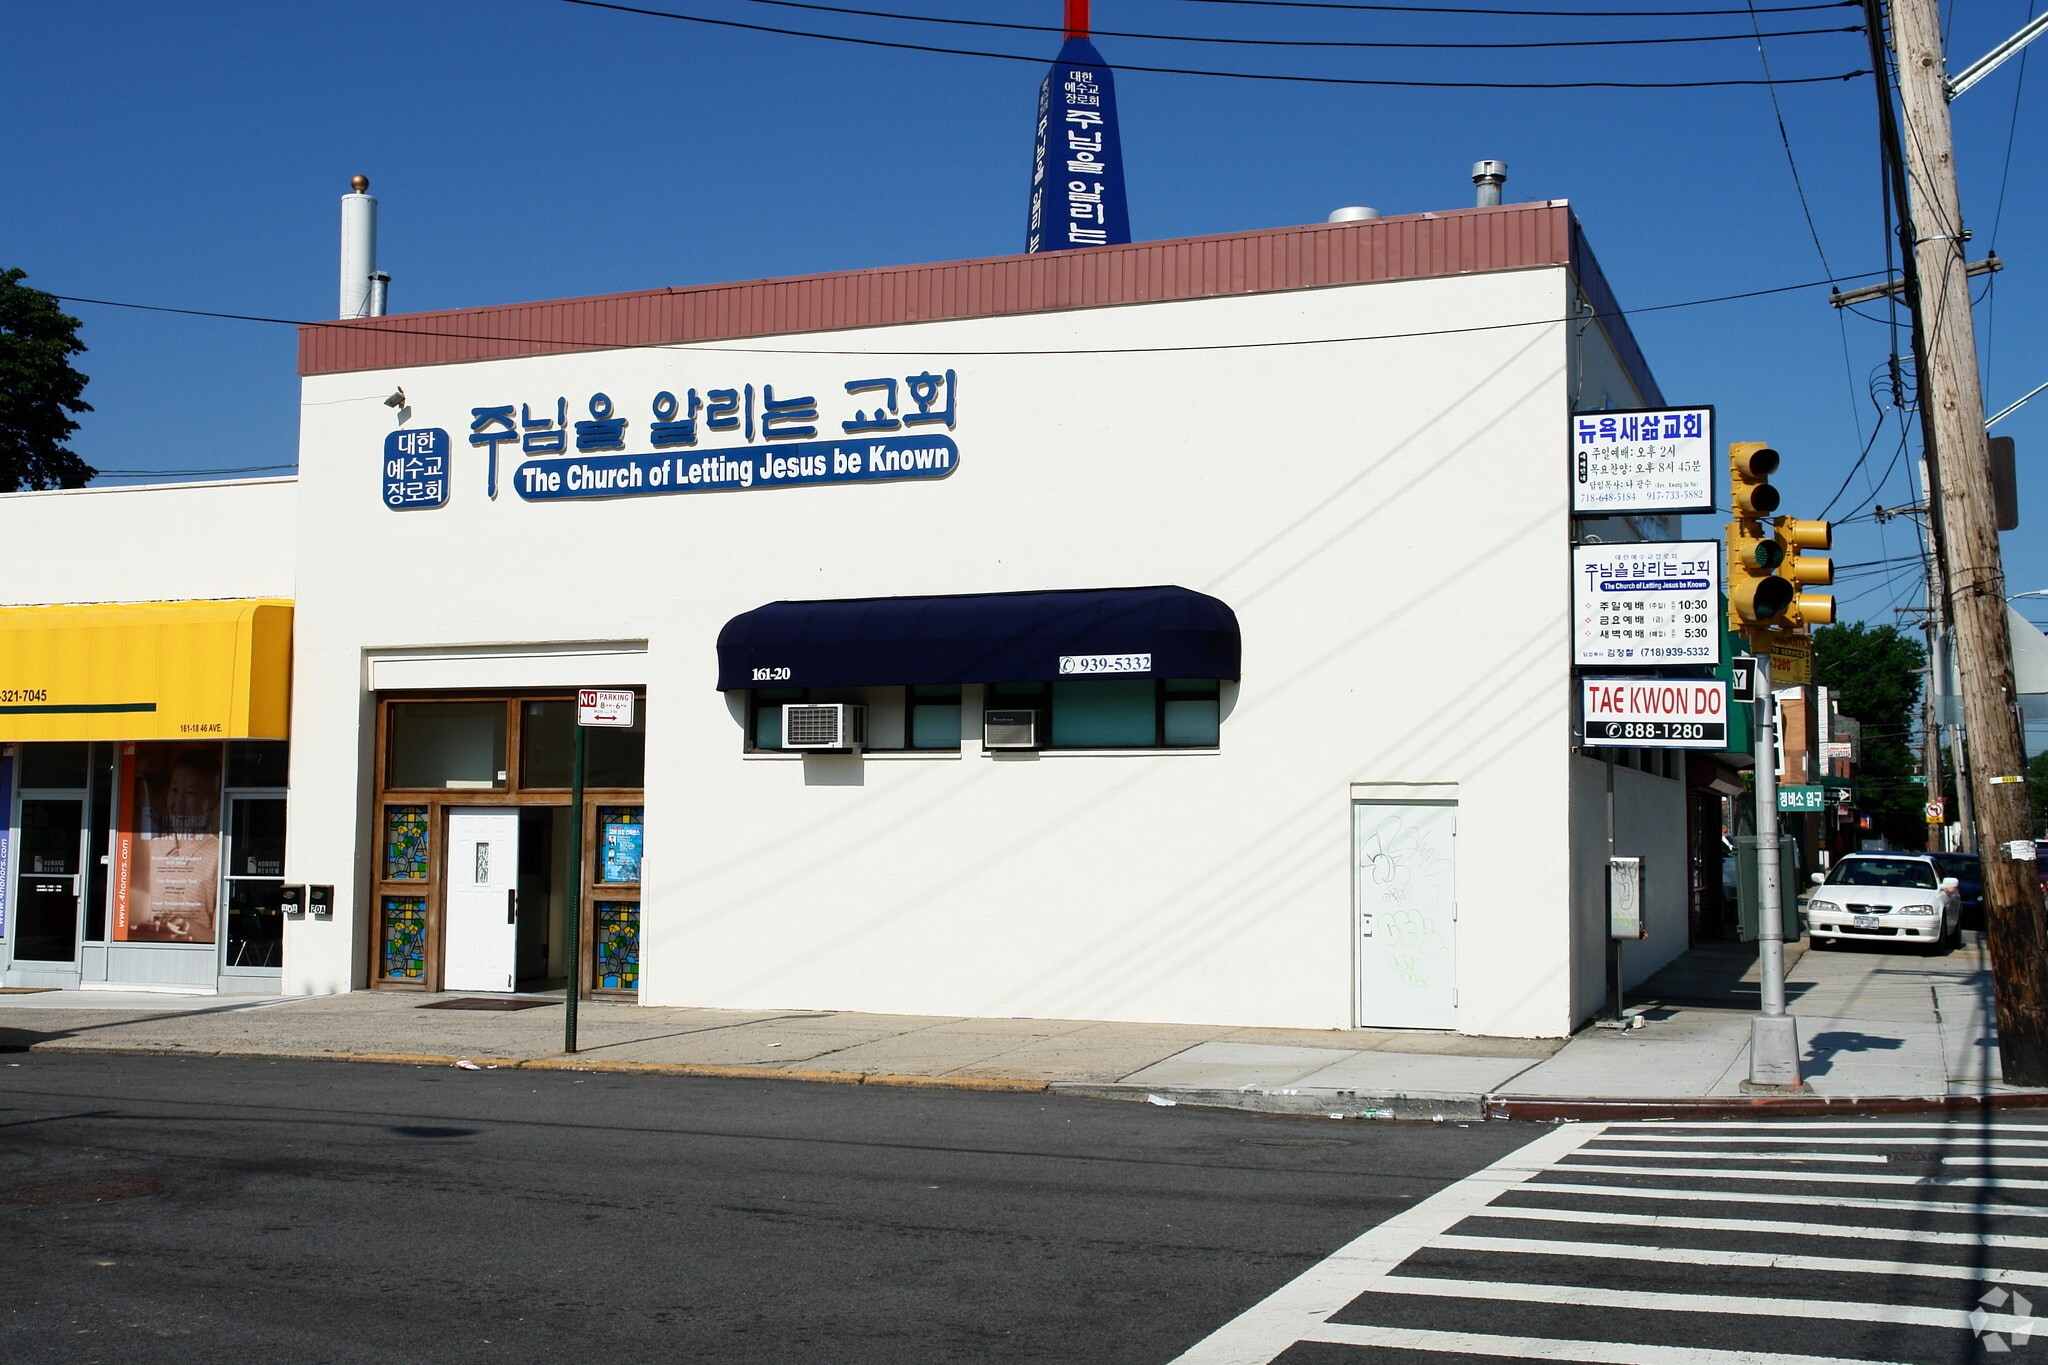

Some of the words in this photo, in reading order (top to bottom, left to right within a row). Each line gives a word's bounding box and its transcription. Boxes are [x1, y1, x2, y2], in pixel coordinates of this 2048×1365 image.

[1070, 71, 1093, 83] 대한
[1064, 82, 1099, 95] 예수교
[1065, 93, 1099, 107] 장로회
[1066, 109, 1105, 175] 주님을
[468, 392, 628, 498] 주님을
[651, 383, 820, 448] 알리는
[841, 368, 957, 432] 교회
[1579, 413, 1702, 444] 뉴욕새삶교회
[398, 432, 435, 455] 대한
[1591, 446, 1634, 460] 주일예배:
[1636, 444, 1656, 459] 오후
[1660, 444, 1676, 458] 2시
[387, 457, 443, 480] 예수교
[522, 466, 560, 493] The
[567, 460, 643, 491] Church
[649, 458, 671, 487] of
[676, 455, 753, 487] Letting
[760, 452, 827, 480] Jesus
[834, 448, 862, 475] be
[869, 445, 949, 472] Known
[1634, 461, 1655, 474] 오후
[1658, 460, 1674, 473] 8시
[387, 480, 443, 505] 장로회
[1581, 493, 1636, 503] 718-648-5184
[1646, 489, 1703, 501] 917-733-5882
[1585, 561, 1629, 592] 주님을
[1632, 561, 1678, 578] 알리는
[1681, 560, 1710, 576] 교회
[1604, 582, 1615, 590] The
[1615, 582, 1635, 590] Church
[1636, 582, 1642, 590] of
[1642, 582, 1662, 591] Letting
[1662, 581, 1679, 589] Jesus
[1680, 581, 1687, 589] be
[1687, 580, 1707, 588] Known
[1678, 599, 1708, 610] 10:30
[1684, 613, 1708, 624] 9:00
[1684, 628, 1708, 638] 5:30
[1080, 655, 1152, 673] 939-5332
[751, 667, 791, 682] 161-20
[580, 692, 597, 706] NO
[599, 693, 629, 701] PARKING
[1589, 686, 1625, 713] TAE
[1630, 687, 1688, 714] KWON
[1695, 687, 1721, 715] DO
[180, 724, 199, 732] 161-18
[208, 723, 223, 732] AVE.
[1625, 723, 1704, 739] 888-1280
[1779, 792, 1804, 808] 정비소
[1806, 791, 1822, 807] 입구
[118, 839, 129, 927] www.4honors.com
[311, 905, 326, 914] 20A
